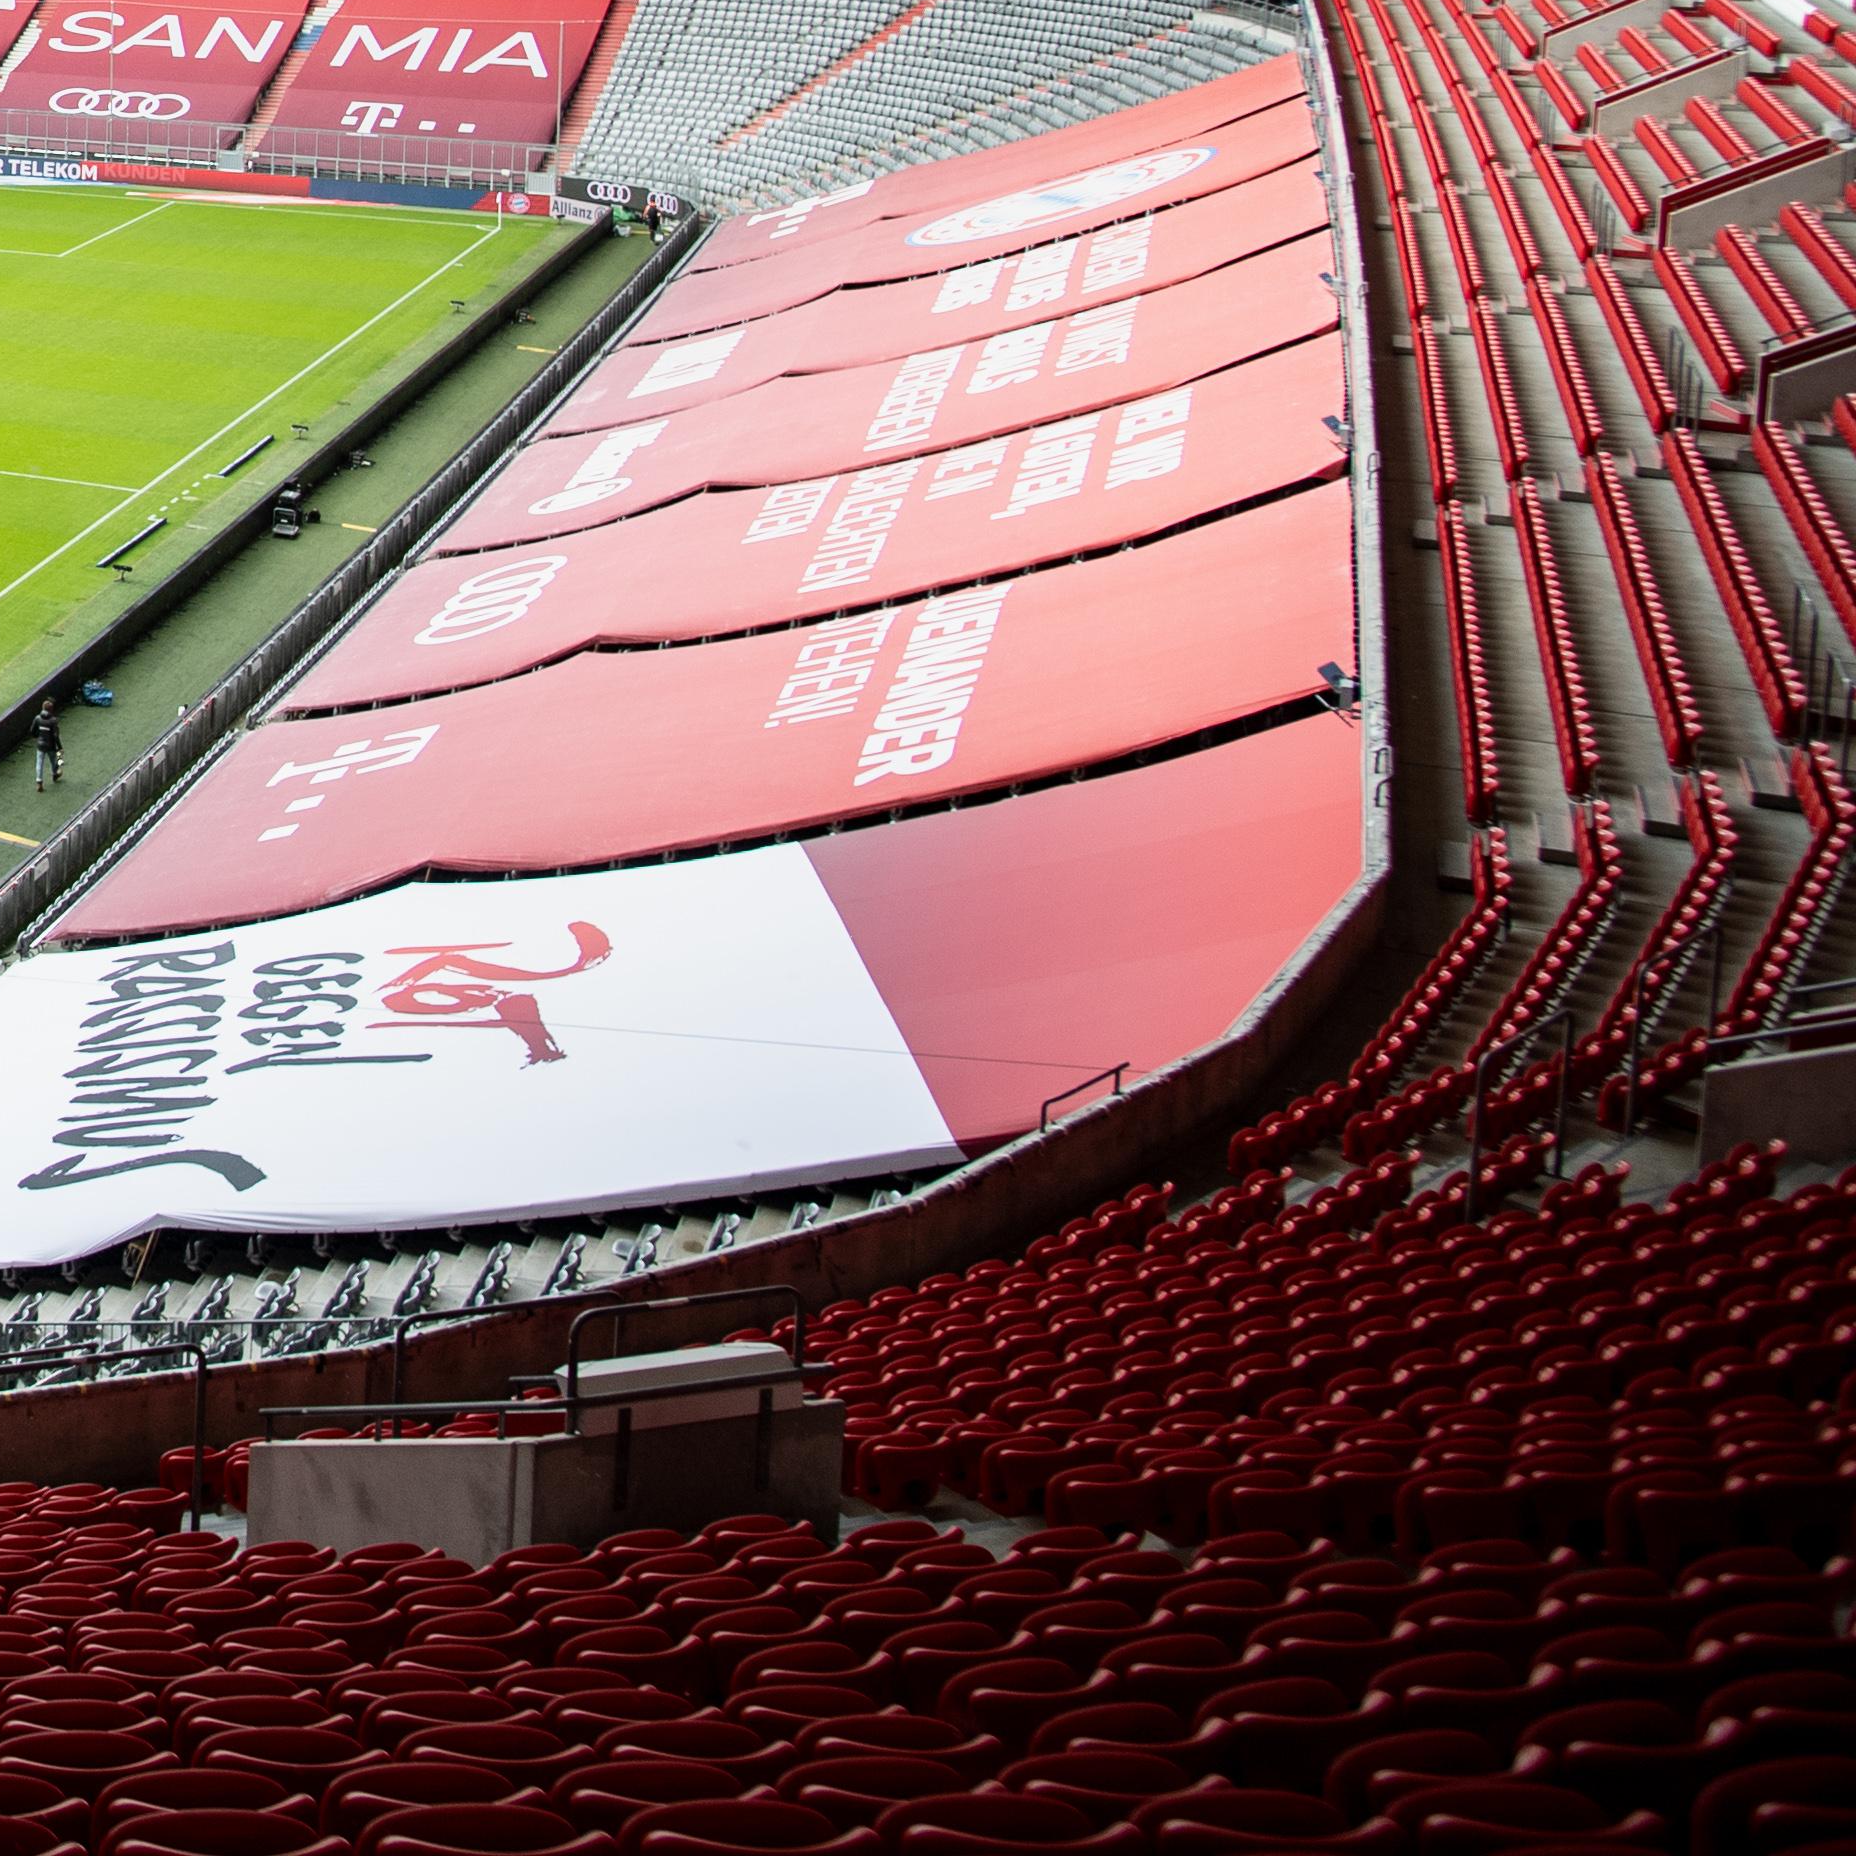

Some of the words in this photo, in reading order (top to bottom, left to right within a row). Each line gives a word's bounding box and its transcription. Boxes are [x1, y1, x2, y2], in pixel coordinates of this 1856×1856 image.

[47, 10, 285, 63] SAN
[329, 24, 550, 79] MIA
[8, 156, 99, 182] TELEKOM
[104, 162, 187, 183] KUNDEN
[551, 199, 593, 220] Allianz
[1104, 429, 1187, 490] WIR
[225, 951, 433, 1075] GEGEN
[365, 920, 613, 1069] ROT
[18, 939, 269, 1192] RASSISMUS
